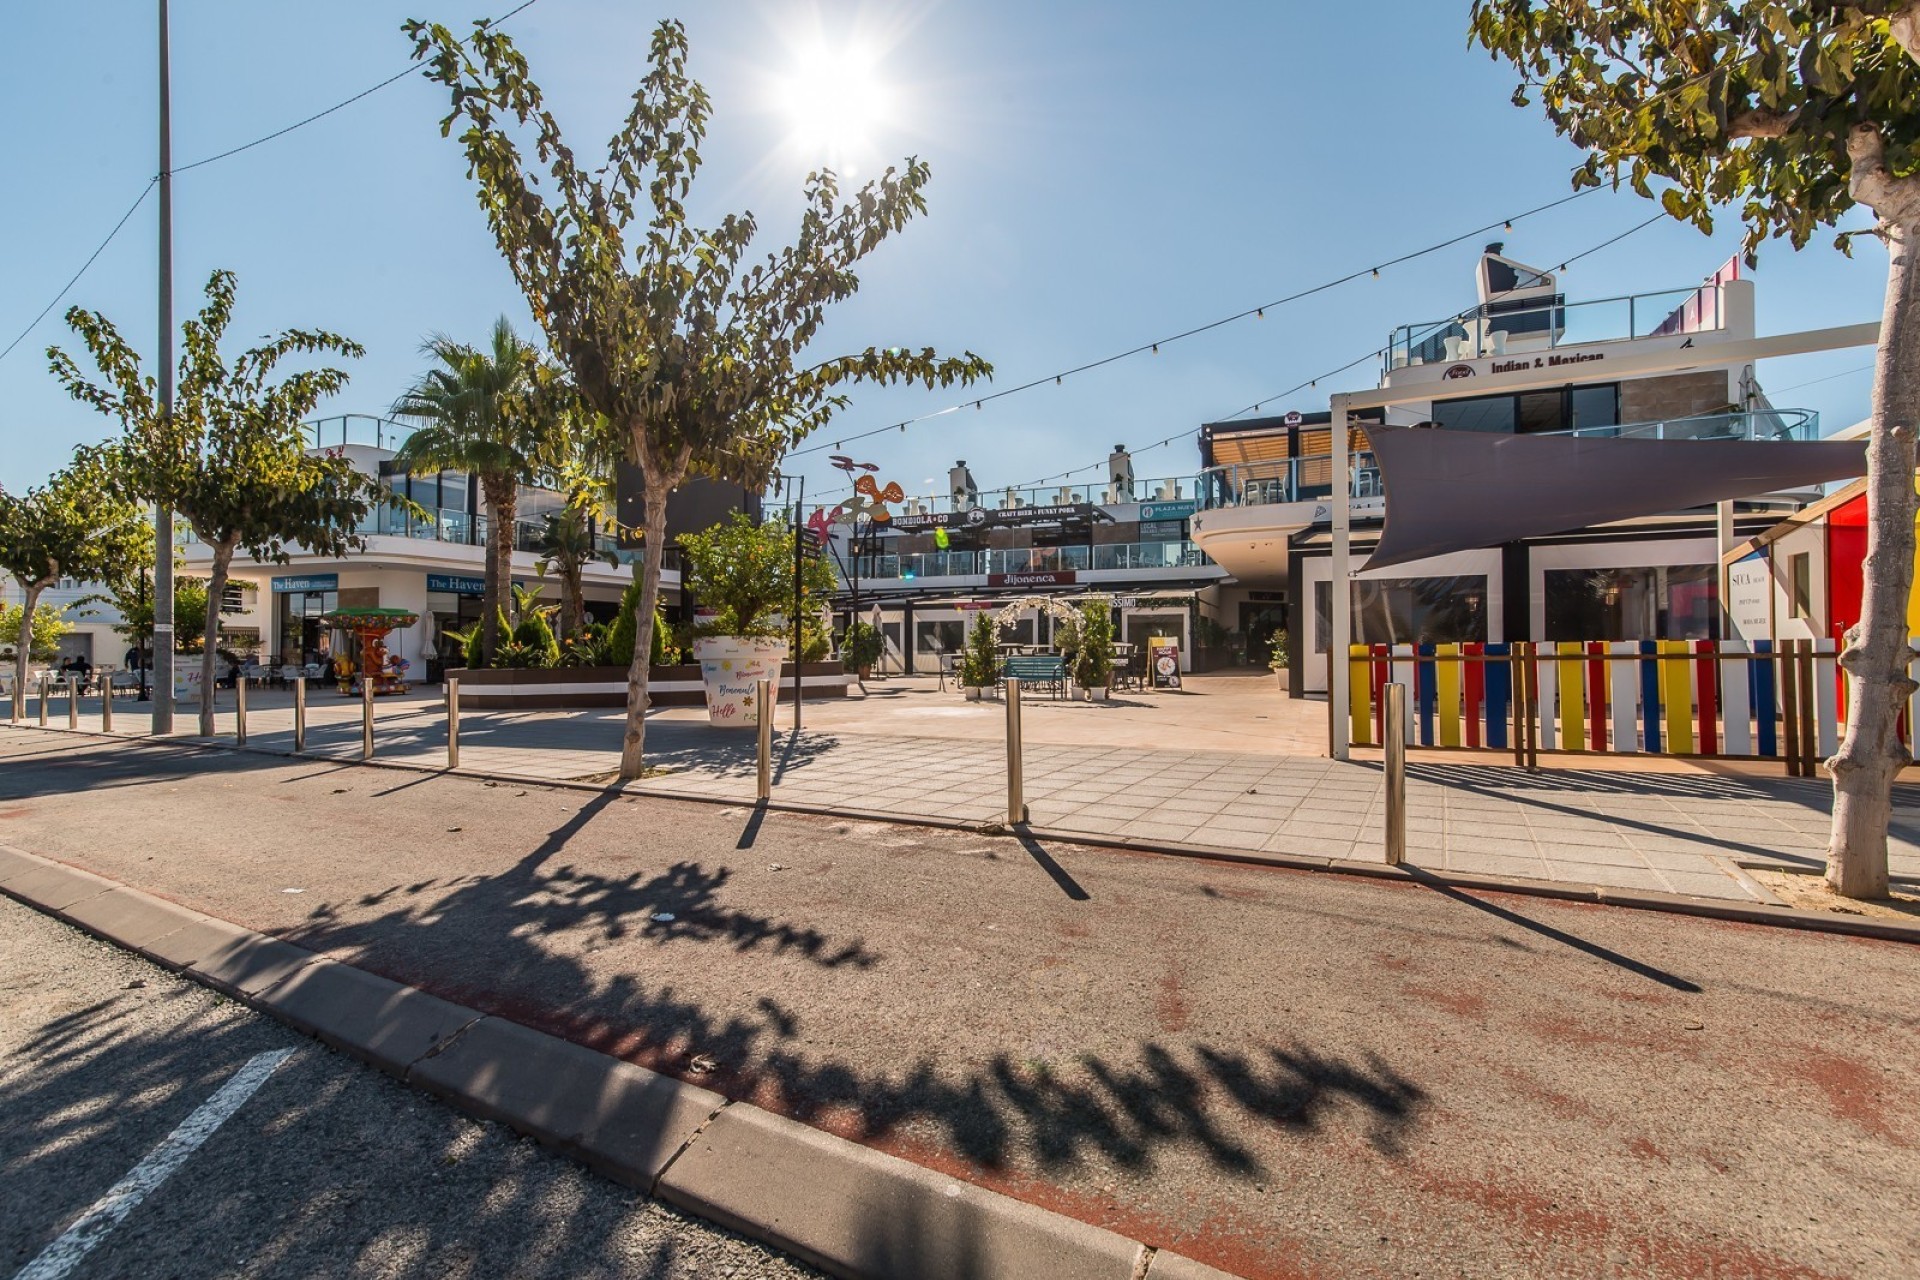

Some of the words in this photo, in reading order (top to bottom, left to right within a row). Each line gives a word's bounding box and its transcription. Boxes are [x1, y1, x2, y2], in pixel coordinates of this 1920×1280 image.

[1492, 360, 1530, 374] Indian
[1534, 358, 1544, 368] &
[1548, 353, 1604, 367] Mexican
[998, 509, 1016, 518] CRAFT
[893, 516, 932, 526] BONDIOLA
[273, 581, 283, 589] The
[284, 578, 310, 589] Haven
[431, 579, 447, 588] The
[449, 577, 486, 591] Haven
[1004, 574, 1056, 586] Jijonenca
[1733, 574, 1751, 586] SUCA
[712, 703, 736, 718] Hello
